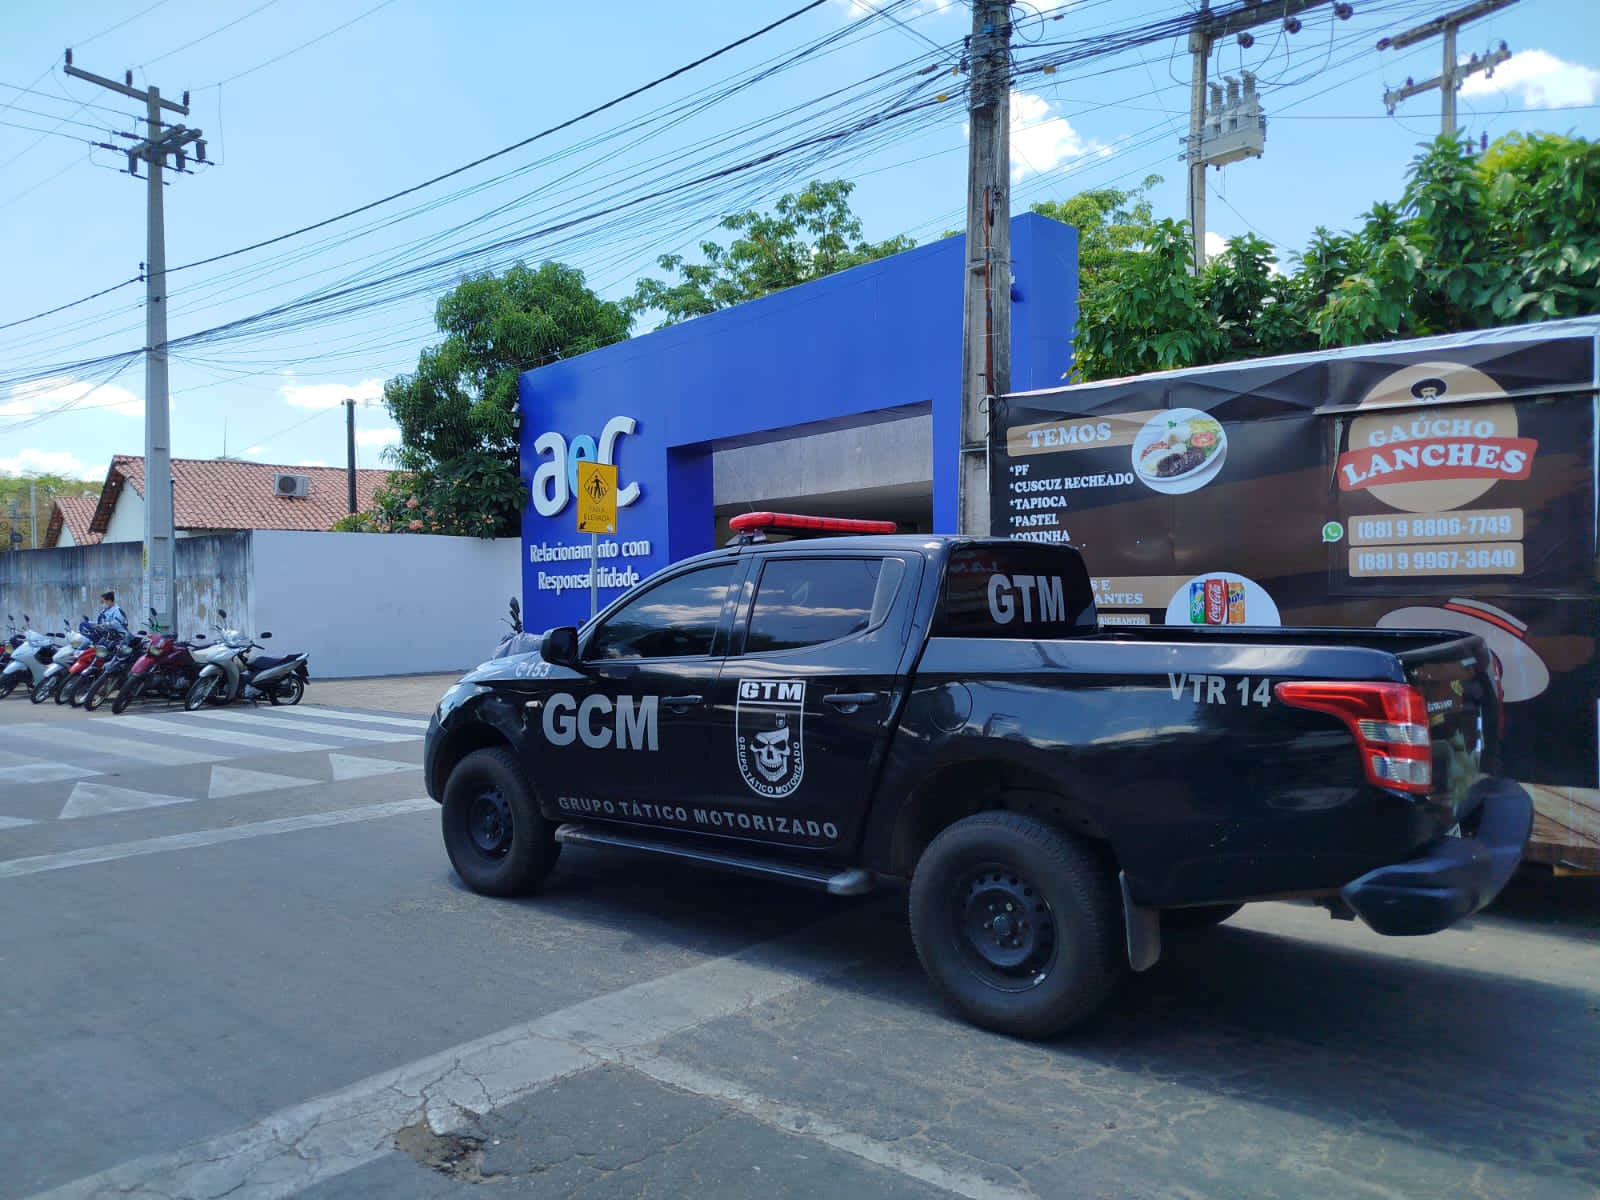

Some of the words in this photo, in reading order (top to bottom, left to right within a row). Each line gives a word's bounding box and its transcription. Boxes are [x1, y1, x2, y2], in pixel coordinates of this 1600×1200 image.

[1027, 422, 1112, 448] TEMOS
[1368, 416, 1495, 448] GAÚCHO
[1342, 443, 1527, 487] LANCHES
[1015, 478, 1063, 493] CUSCUZ
[1064, 473, 1134, 490] RECHEADO
[1014, 495, 1067, 510] TAPIOCA
[1015, 514, 1059, 527] PASTEL
[1397, 518, 1408, 538] 9
[1412, 514, 1512, 538] 8806-7749
[530, 539, 618, 563] Relacionamnto
[621, 540, 650, 557] com
[1397, 550, 1409, 571] 9
[1412, 547, 1517, 570] 9967-3640
[987, 573, 1065, 625] GTM
[741, 682, 803, 701] GTM
[1168, 672, 1227, 705] VTR
[1236, 677, 1272, 708] 14
[542, 691, 660, 752] GCM
[737, 736, 748, 772] GRUPO
[775, 741, 801, 795] MOTORIZADO
[558, 796, 614, 815] GRUPO
[619, 798, 688, 822] TÁTICO
[693, 808, 840, 840] MOTORIZADO
